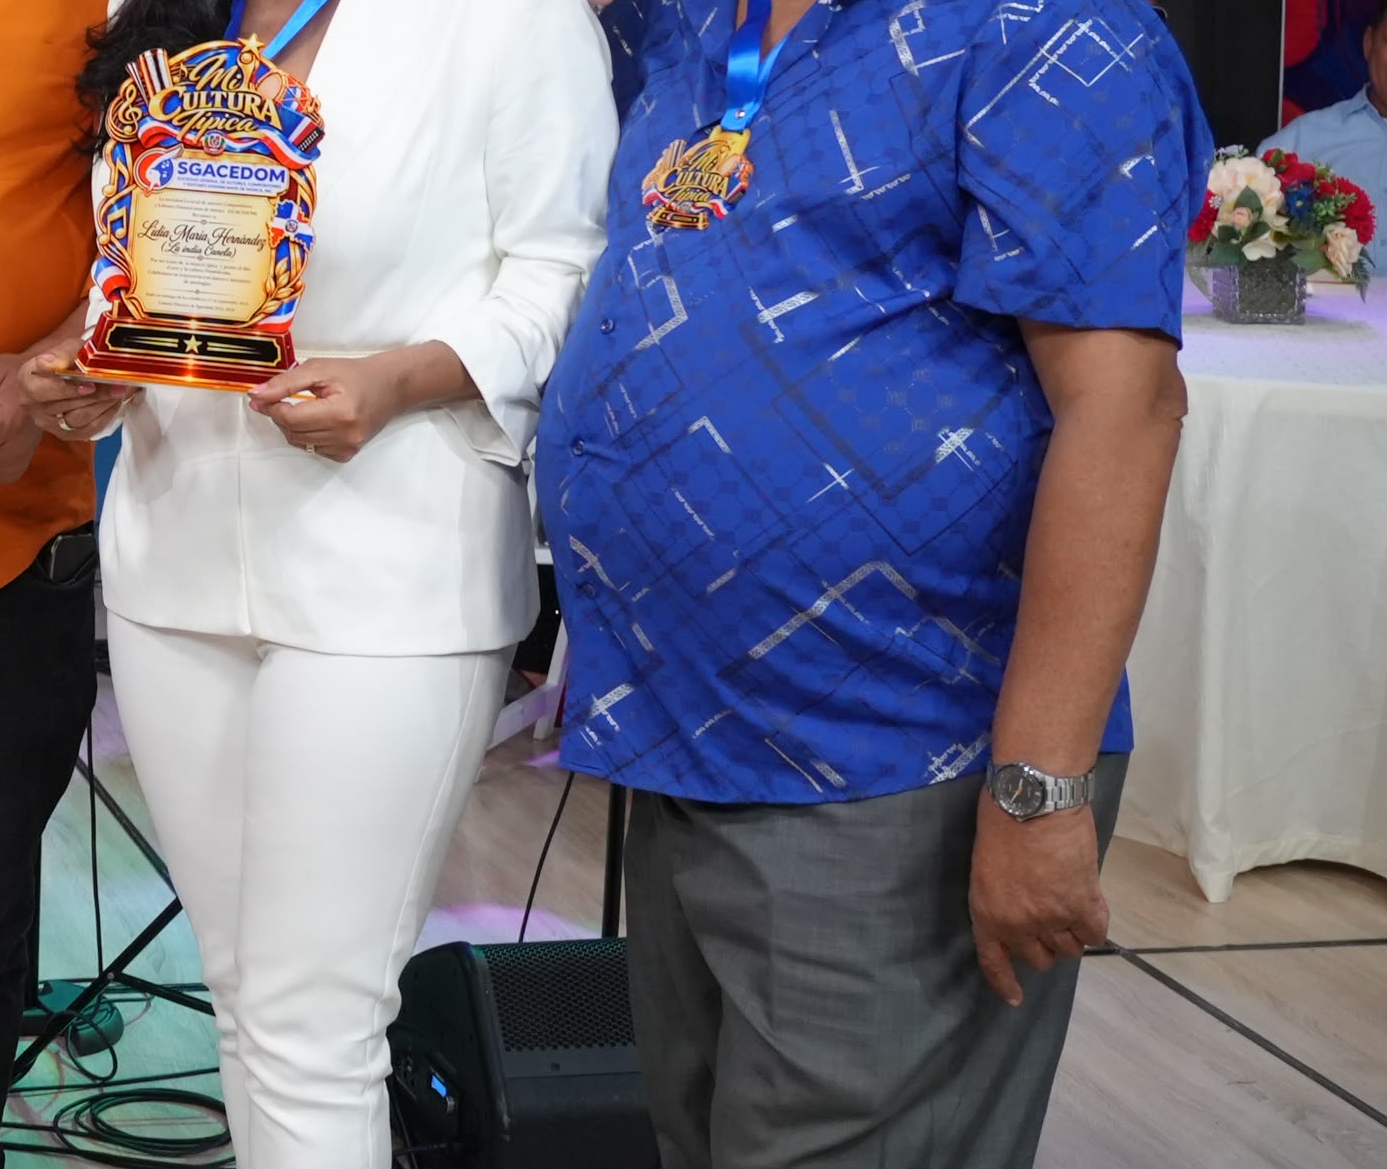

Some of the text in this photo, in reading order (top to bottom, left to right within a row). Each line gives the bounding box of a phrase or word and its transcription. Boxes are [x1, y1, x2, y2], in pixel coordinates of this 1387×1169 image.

[189, 53, 242, 91] Mi
[149, 85, 283, 130] CULTURA
[177, 161, 286, 183] SGACEDOM
[657, 166, 729, 199] CULTURA
